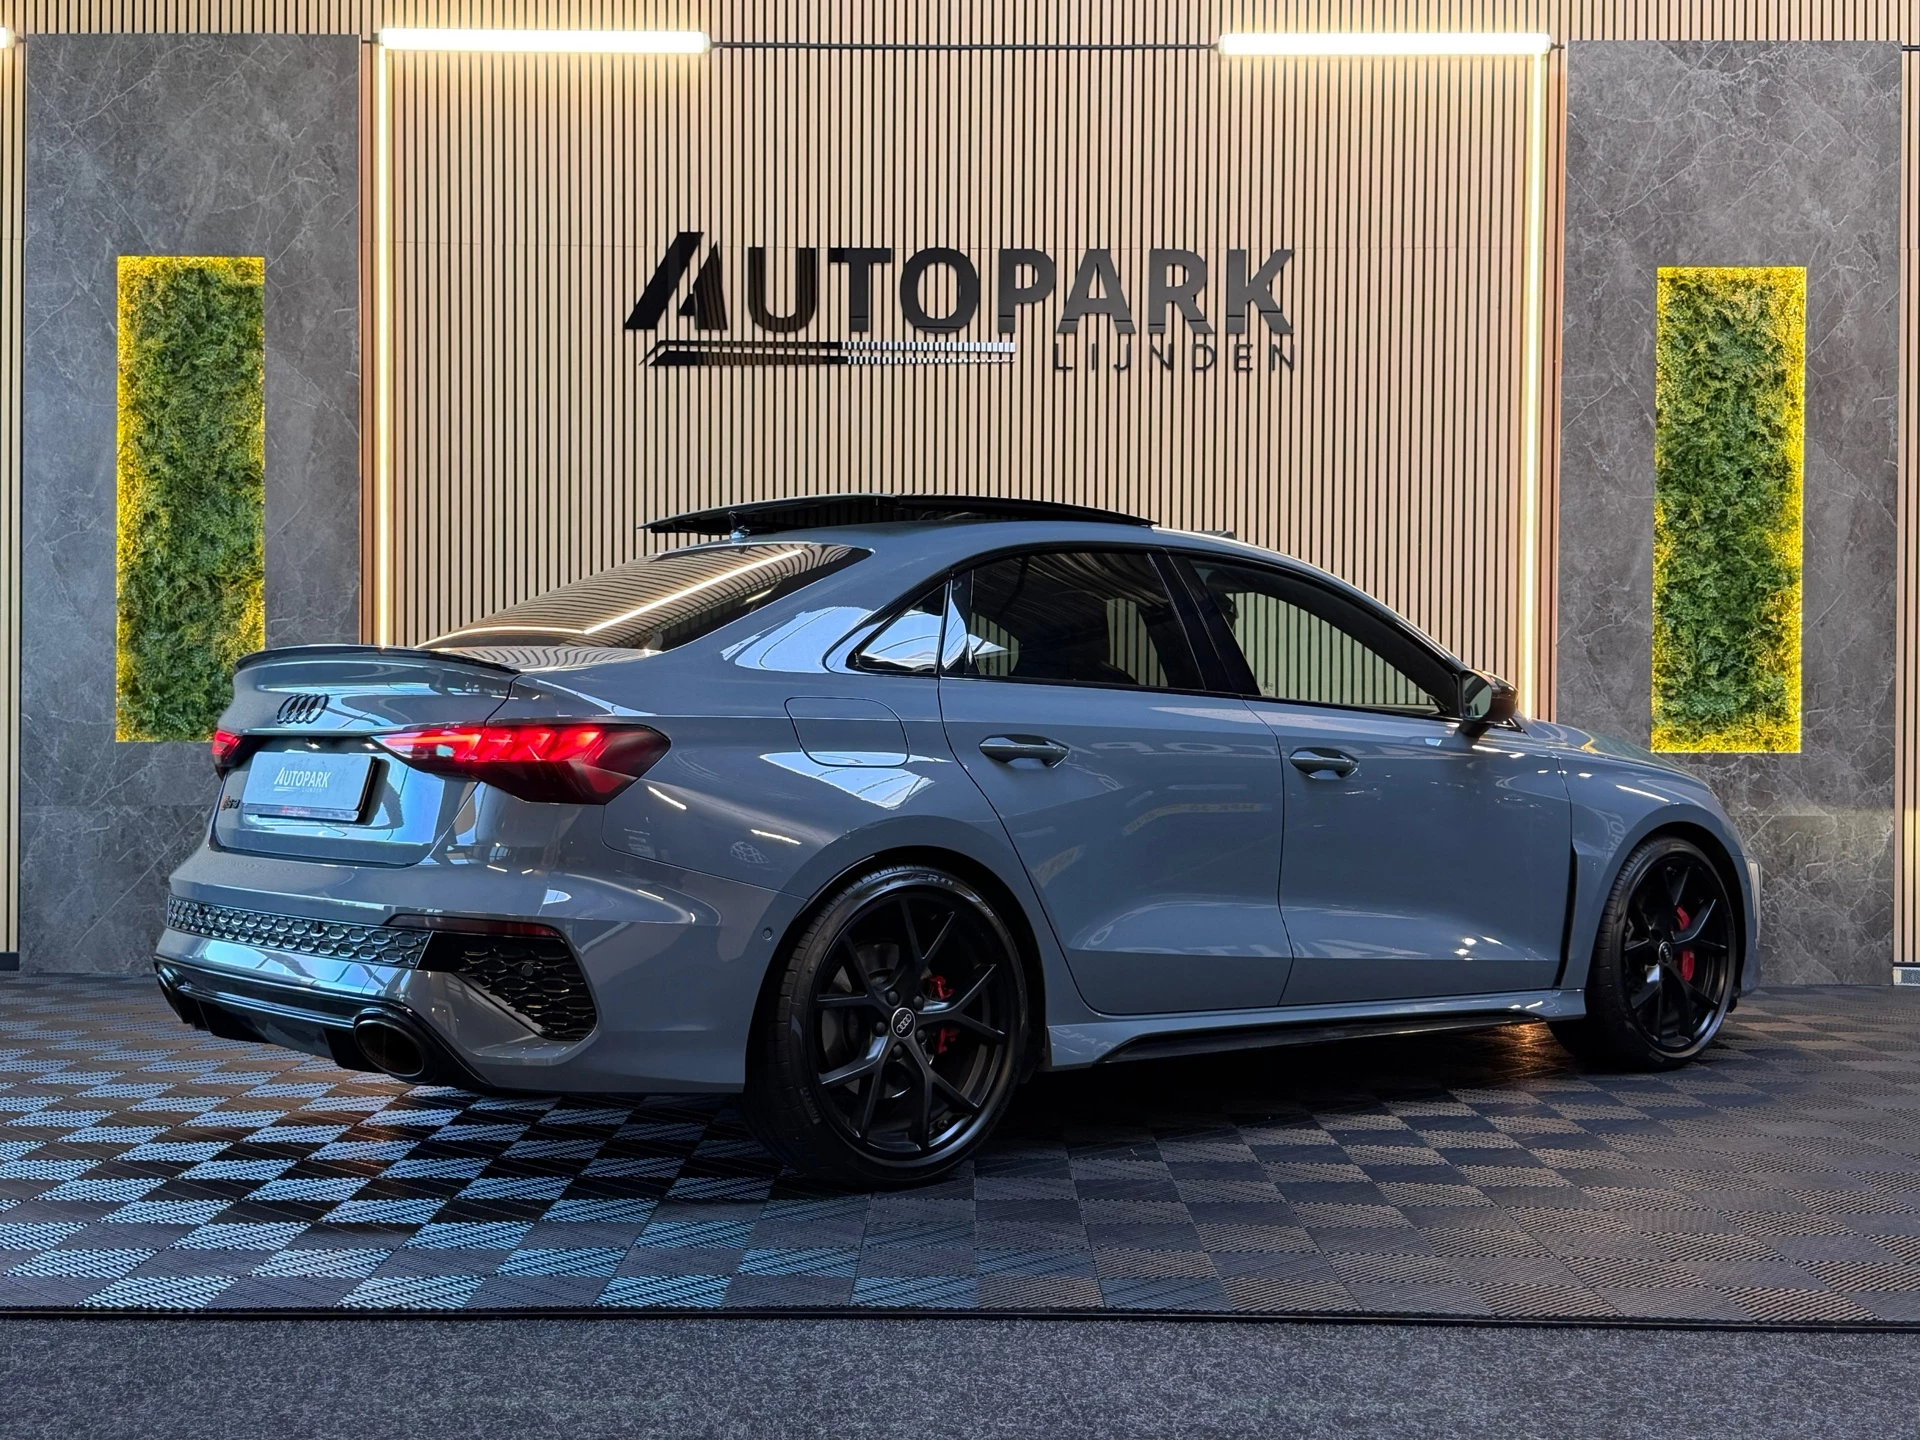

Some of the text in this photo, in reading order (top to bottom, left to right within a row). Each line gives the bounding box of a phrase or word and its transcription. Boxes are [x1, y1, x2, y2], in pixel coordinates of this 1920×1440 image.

[624, 232, 1295, 334] AUTOPARK
[1052, 343, 1294, 371] LIJNDEN
[274, 767, 331, 788] AUTOPARK
